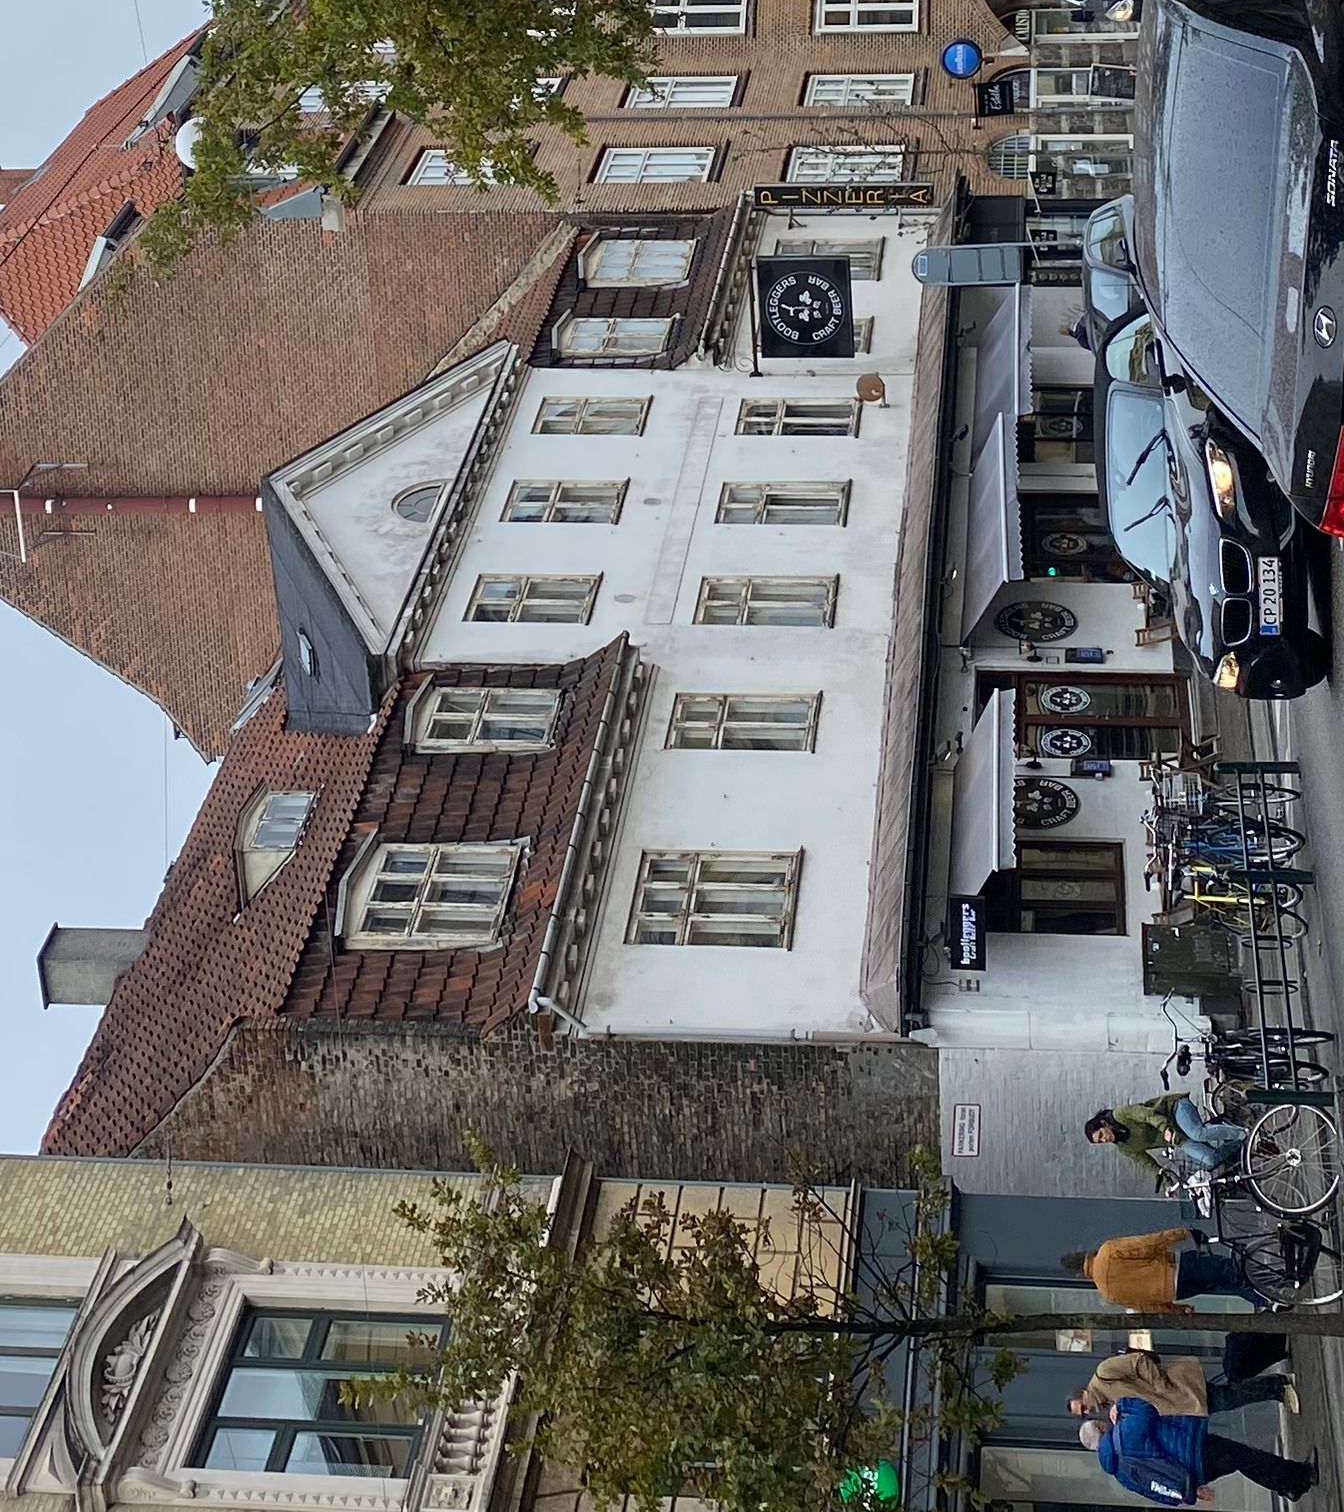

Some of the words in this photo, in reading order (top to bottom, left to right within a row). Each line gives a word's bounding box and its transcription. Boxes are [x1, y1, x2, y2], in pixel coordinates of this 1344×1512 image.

[1325, 139, 1340, 208] SONATA
[759, 189, 928, 205] PIZZERIA
[807, 275, 830, 291] BAR
[768, 276, 800, 341] BOOTLEGGERS
[828, 289, 842, 316] BEER
[812, 316, 840, 341] CRAFT
[1304, 449, 1318, 489] HYUNDAI
[1261, 559, 1276, 584] 134
[1262, 588, 1277, 605] 20
[1263, 607, 1277, 625] CP
[1039, 779, 1064, 791] BAR
[1063, 789, 1077, 809] BEER
[1040, 808, 1071, 826] CRAFT
